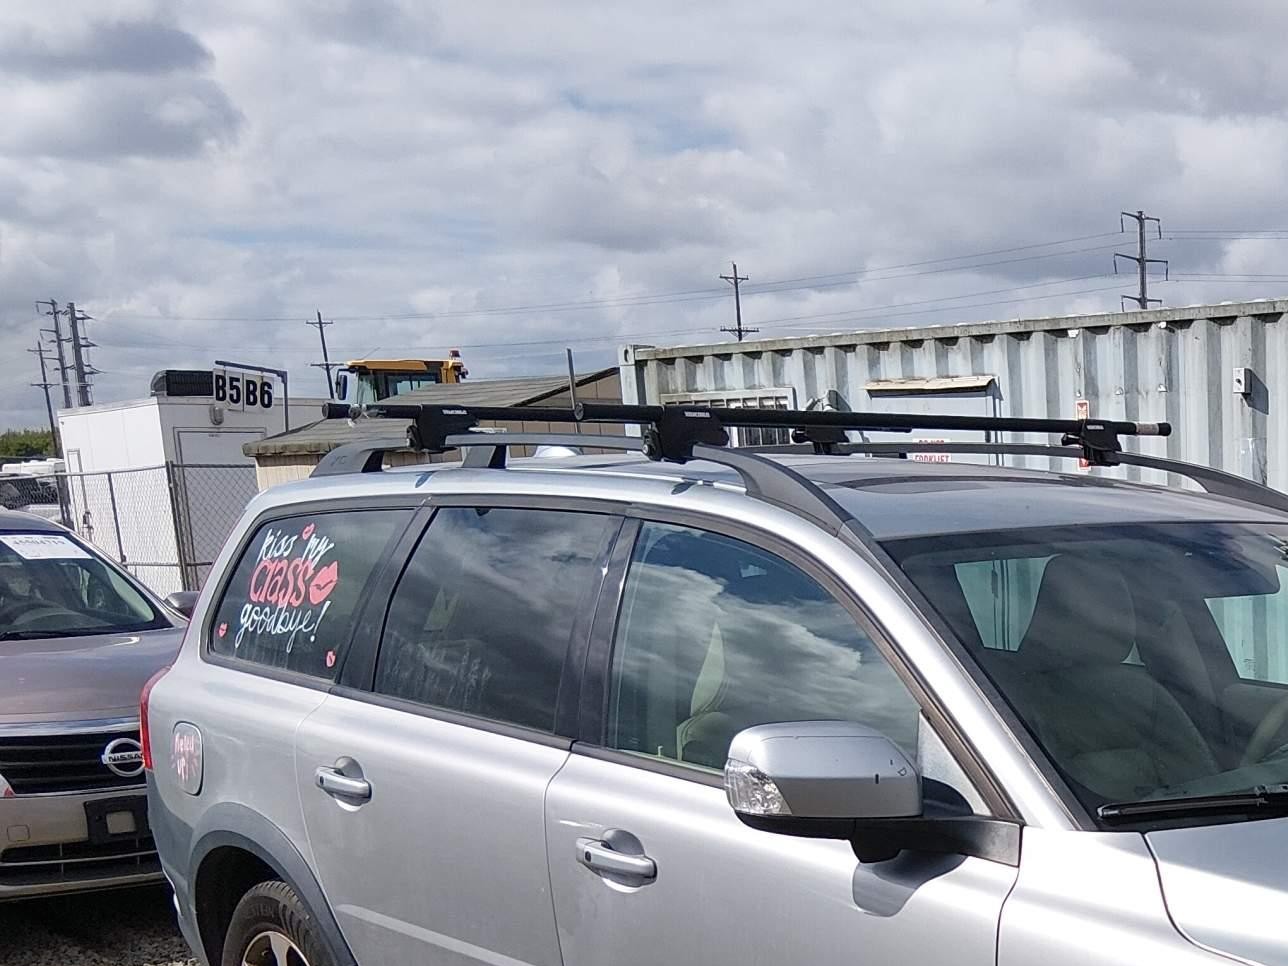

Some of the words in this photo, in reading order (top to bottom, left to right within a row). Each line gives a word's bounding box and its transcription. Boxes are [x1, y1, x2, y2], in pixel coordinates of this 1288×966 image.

[256, 528, 298, 565] kiss
[302, 533, 335, 571] my
[235, 601, 331, 653] goodbye!
